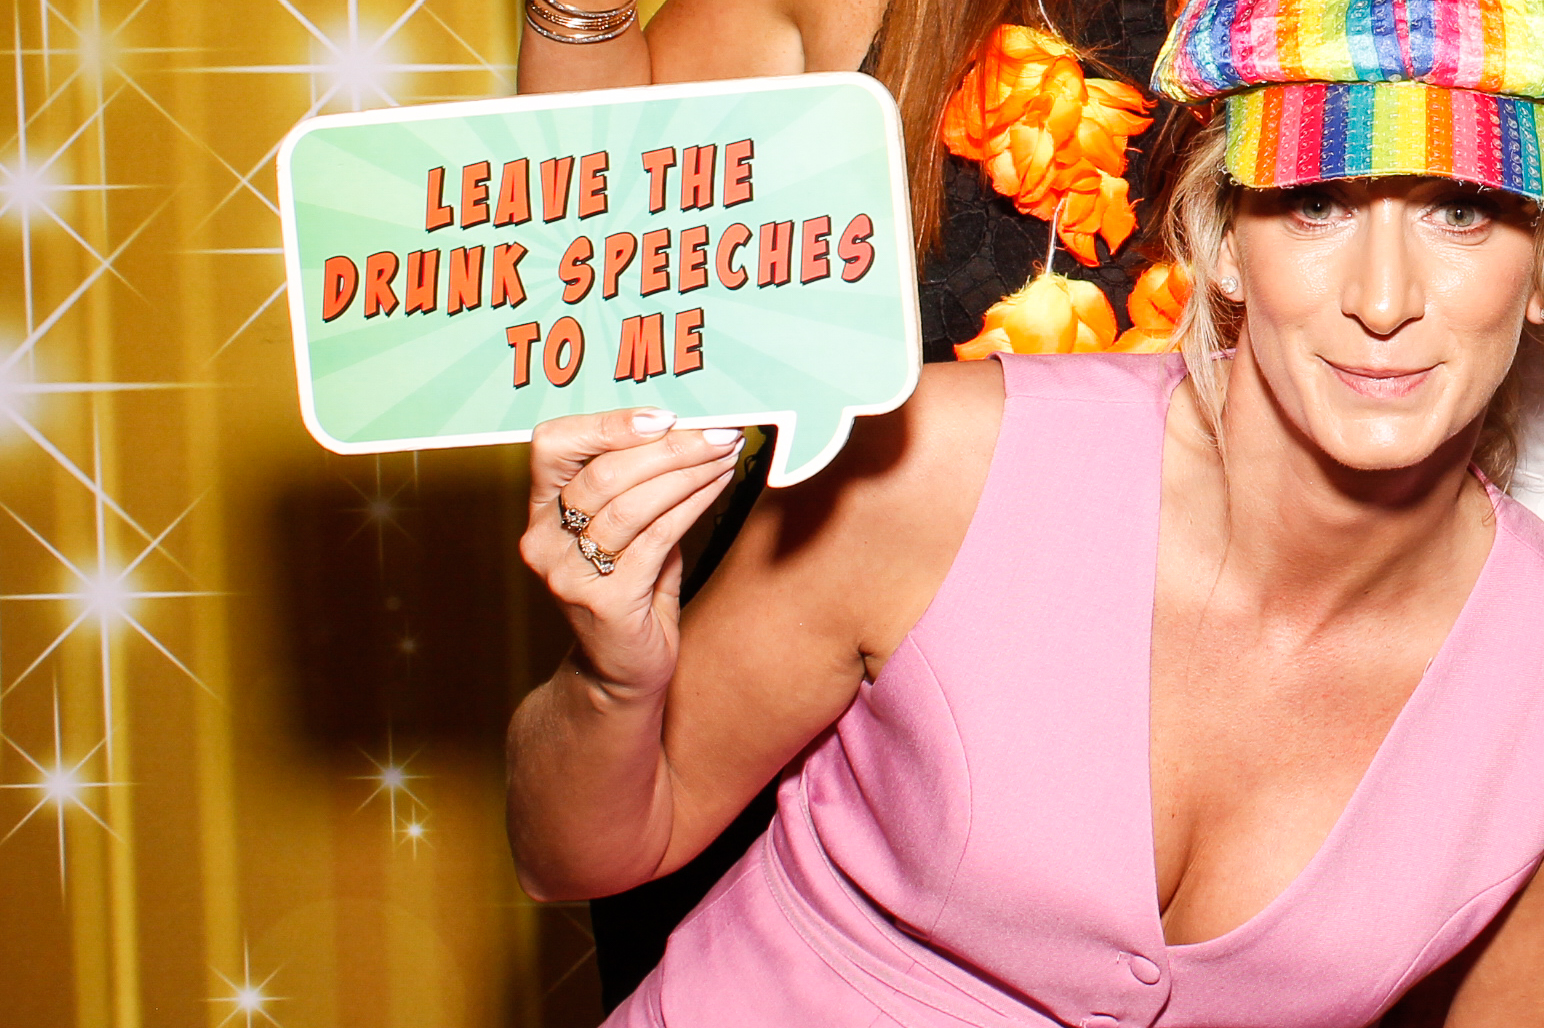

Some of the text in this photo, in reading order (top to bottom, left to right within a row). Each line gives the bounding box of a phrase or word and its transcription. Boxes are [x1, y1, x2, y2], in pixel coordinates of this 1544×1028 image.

[425, 138, 754, 232] LEAVE THE
[322, 213, 875, 322] DRUNK SPEECHES
[505, 308, 704, 388] TO ME
